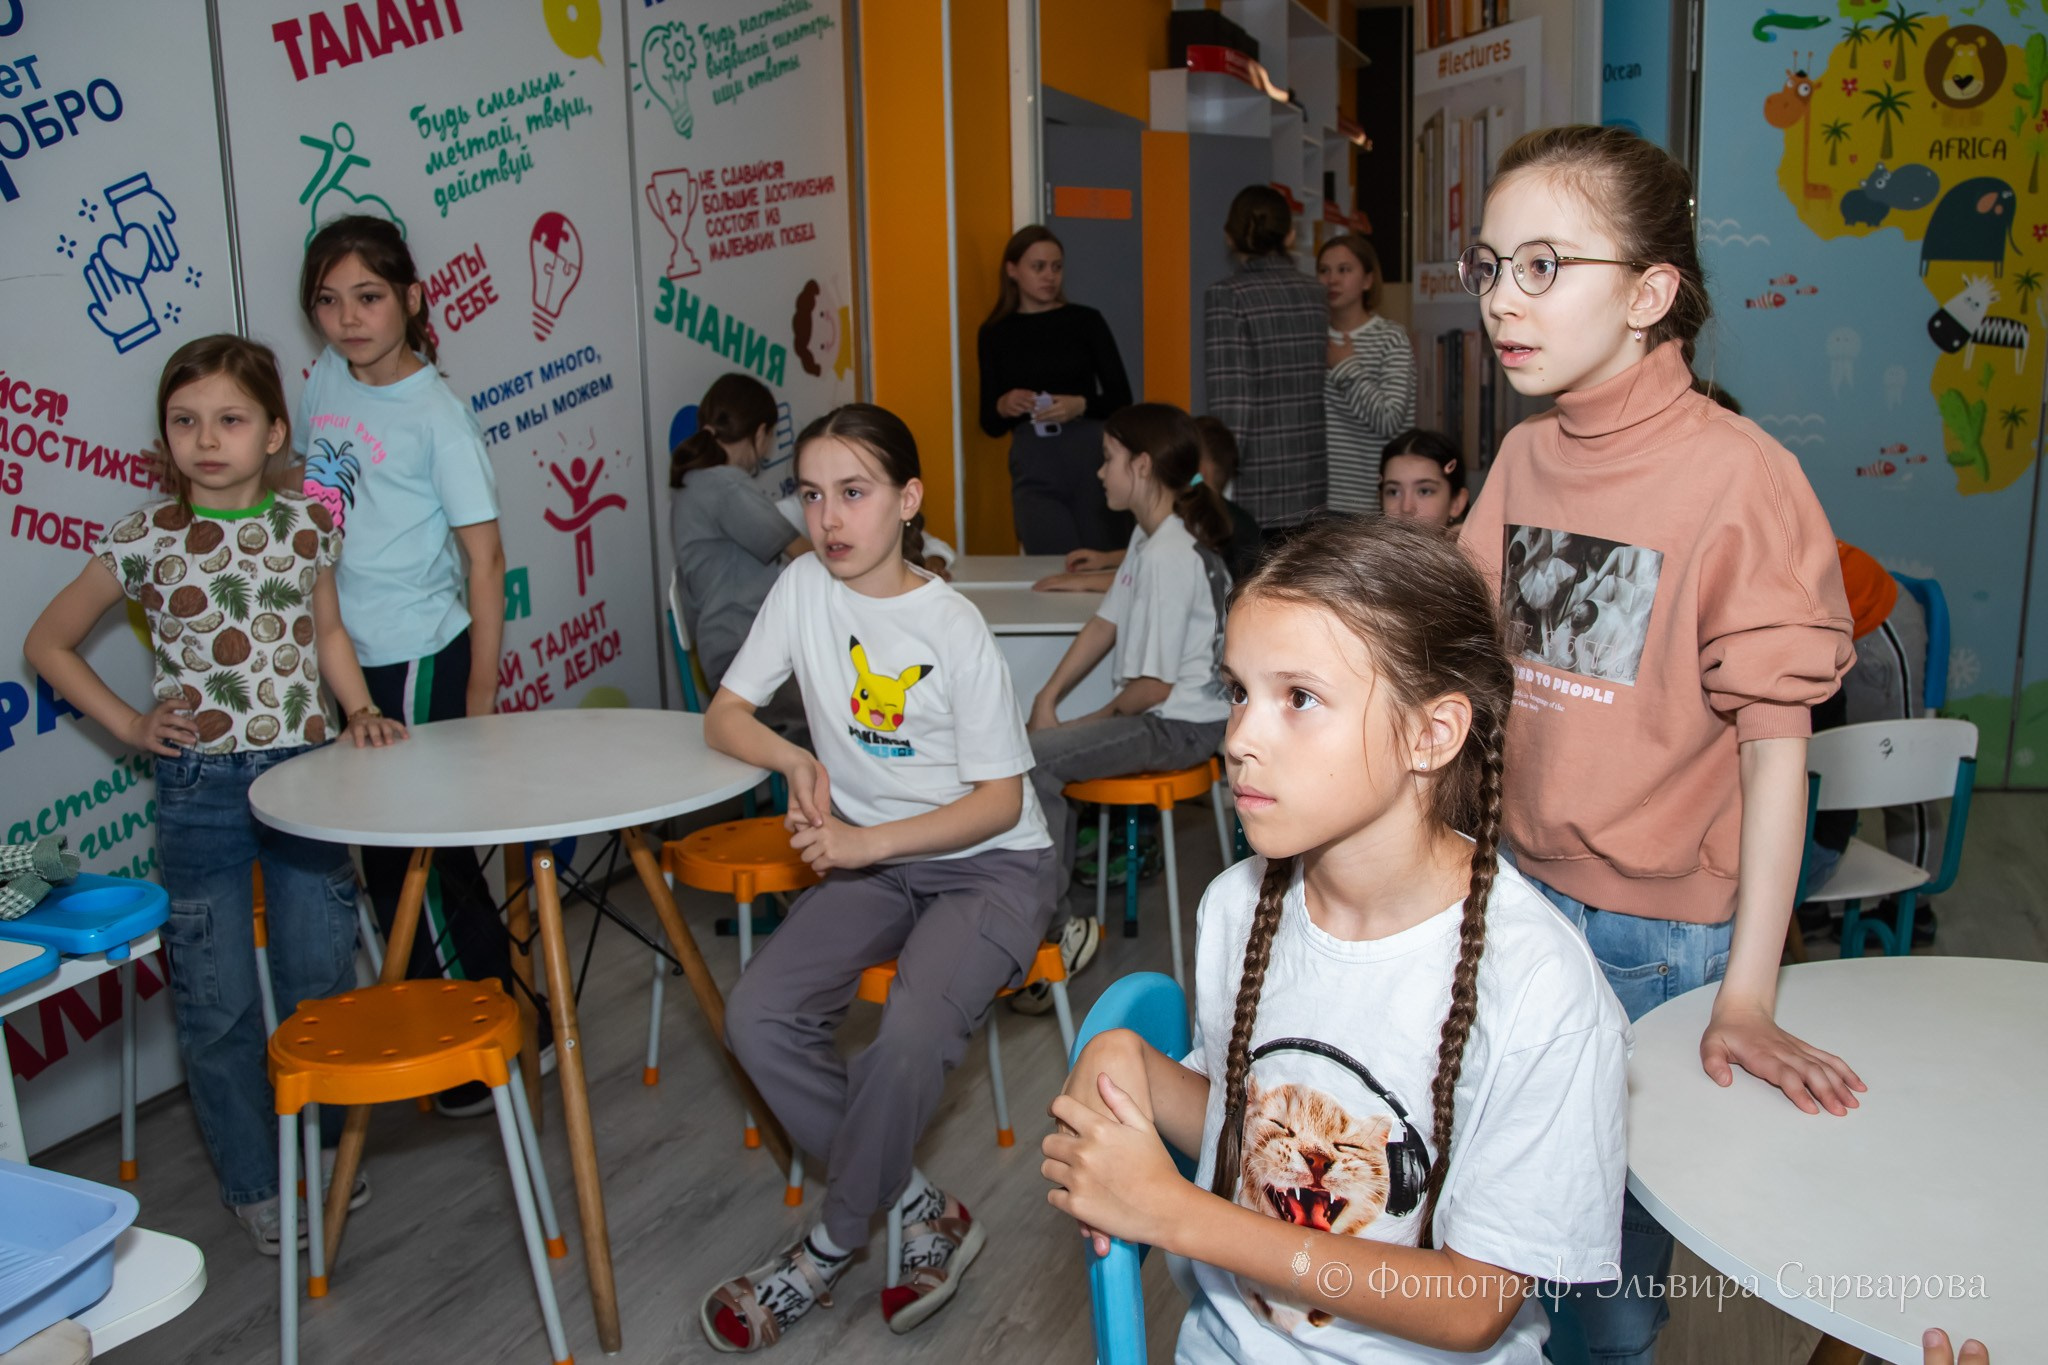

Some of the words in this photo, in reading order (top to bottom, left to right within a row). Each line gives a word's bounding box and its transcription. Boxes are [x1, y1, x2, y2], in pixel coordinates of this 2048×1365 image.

[1438, 39, 1511, 79] #lectures
[1603, 62, 1642, 83] Ocean
[0, 78, 123, 160] ОБРО
[410, 104, 471, 142] Будь
[477, 72, 565, 118] смелым
[426, 116, 522, 175] мечтай,
[526, 95, 592, 134] твори,
[1929, 137, 2007, 160] AFRICA
[434, 144, 535, 218] действуй
[698, 169, 717, 190] НЕ
[705, 210, 760, 238] СОСТОЯТ
[764, 206, 781, 227] ИЗ
[780, 221, 817, 247] ПОБЕД
[443, 274, 499, 332] СЕБЕ
[654, 276, 788, 388] ЗНАНИЯ
[471, 369, 535, 413] может
[540, 345, 602, 384] много,
[515, 403, 549, 433] мы
[552, 373, 615, 416] можем
[0, 416, 168, 495] ОСТИЖЕ
[531, 600, 606, 668] ТАЛАНТ
[564, 629, 622, 689] ДЕЛО!
[1535, 671, 1551, 688] TO
[1552, 677, 1615, 705] PEOPLE
